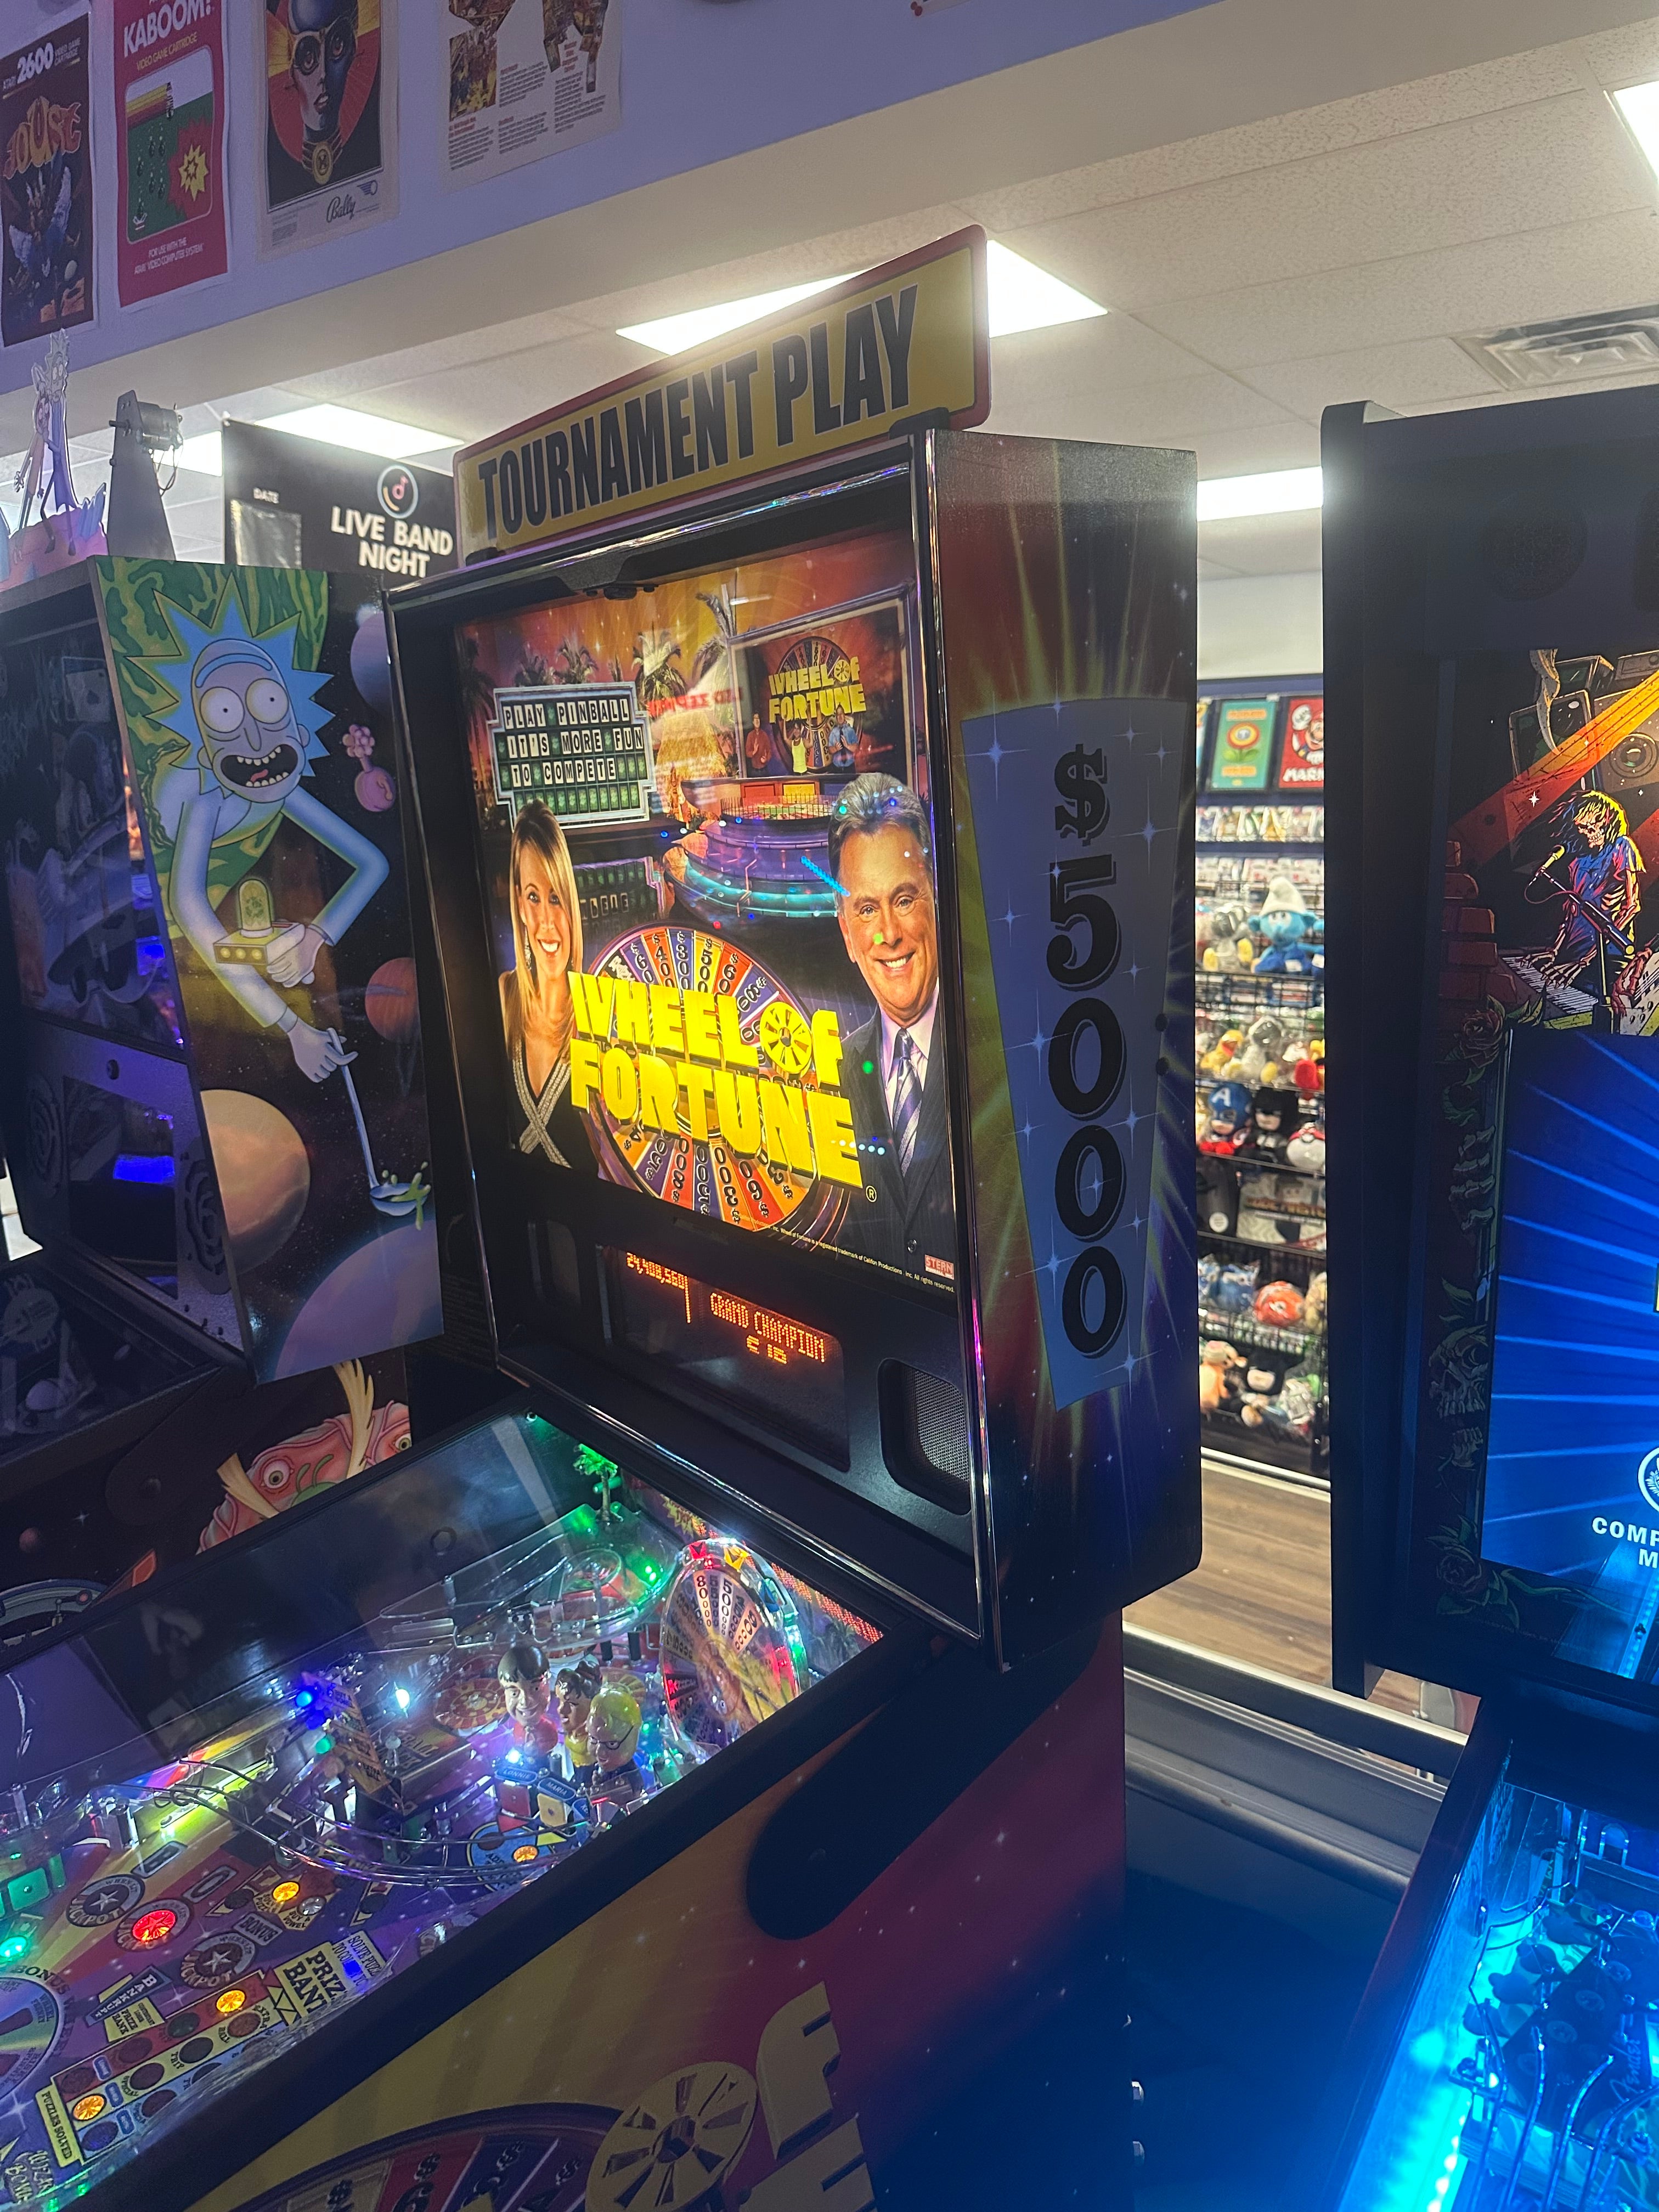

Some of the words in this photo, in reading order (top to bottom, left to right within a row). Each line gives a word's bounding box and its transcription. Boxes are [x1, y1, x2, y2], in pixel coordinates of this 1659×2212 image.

[124, 0, 211, 58] KABOOM!
[17, 42, 54, 84] 2600
[137, 57, 154, 71] VIDEO
[153, 47, 168, 64] GAME
[168, 31, 198, 54] CARTRIDGE
[3, 97, 82, 180] JOUST
[326, 194, 356, 223] Bally
[478, 349, 758, 540] TOURNAMENT
[773, 284, 918, 447] PLAY
[253, 487, 280, 504] DATE
[330, 505, 386, 541] LIVE
[393, 520, 454, 556] BAND
[358, 540, 431, 579] NIGHT
[768, 664, 834, 696] WHEEL
[504, 704, 546, 729] PLAY
[557, 699, 629, 725] PINBALL
[769, 684, 867, 724] FORTUNE
[507, 733, 549, 758] IT'S
[561, 730, 602, 754] MORE
[613, 726, 643, 751] FUN
[511, 764, 532, 786] TO
[543, 758, 616, 785] COMPETE
[568, 970, 759, 1069] WHEEL
[570, 1038, 864, 1189] FORTUNE
[837, 1247, 859, 1260] trademark
[925, 1256, 953, 1274] STERN
[710, 1292, 749, 1329] GRAND
[754, 1311, 825, 1363] CHAMPION
[503, 1768, 532, 1780] LONNIE
[548, 1781, 568, 1796] MARIA
[69, 1898, 120, 1926] JACKPOT
[283, 1917, 307, 1928] VOWEL
[289, 1910, 301, 1921] BUY
[240, 1915, 279, 1942] BONUS
[332, 1942, 347, 1954] TO
[348, 1935, 371, 1961] SOLVE
[11, 1965, 71, 1995] BONUS
[180, 1954, 233, 1988] JACKPOT
[305, 1950, 348, 2000] PRIZ
[94, 1974, 158, 2018] BANKRUPT
[112, 2013, 129, 2035] BANK
[121, 2008, 138, 2030] PRIZE
[251, 2003, 270, 2029] EXTRA
[218, 2027, 230, 2044] BALL
[171, 2051, 185, 2069] TRIP
[121, 2075, 139, 2097] SPECIAL
[41, 2090, 60, 2128] PUZZLES
[54, 2123, 73, 2160] SOLVED
[28, 2149, 55, 2193] WIZAR
